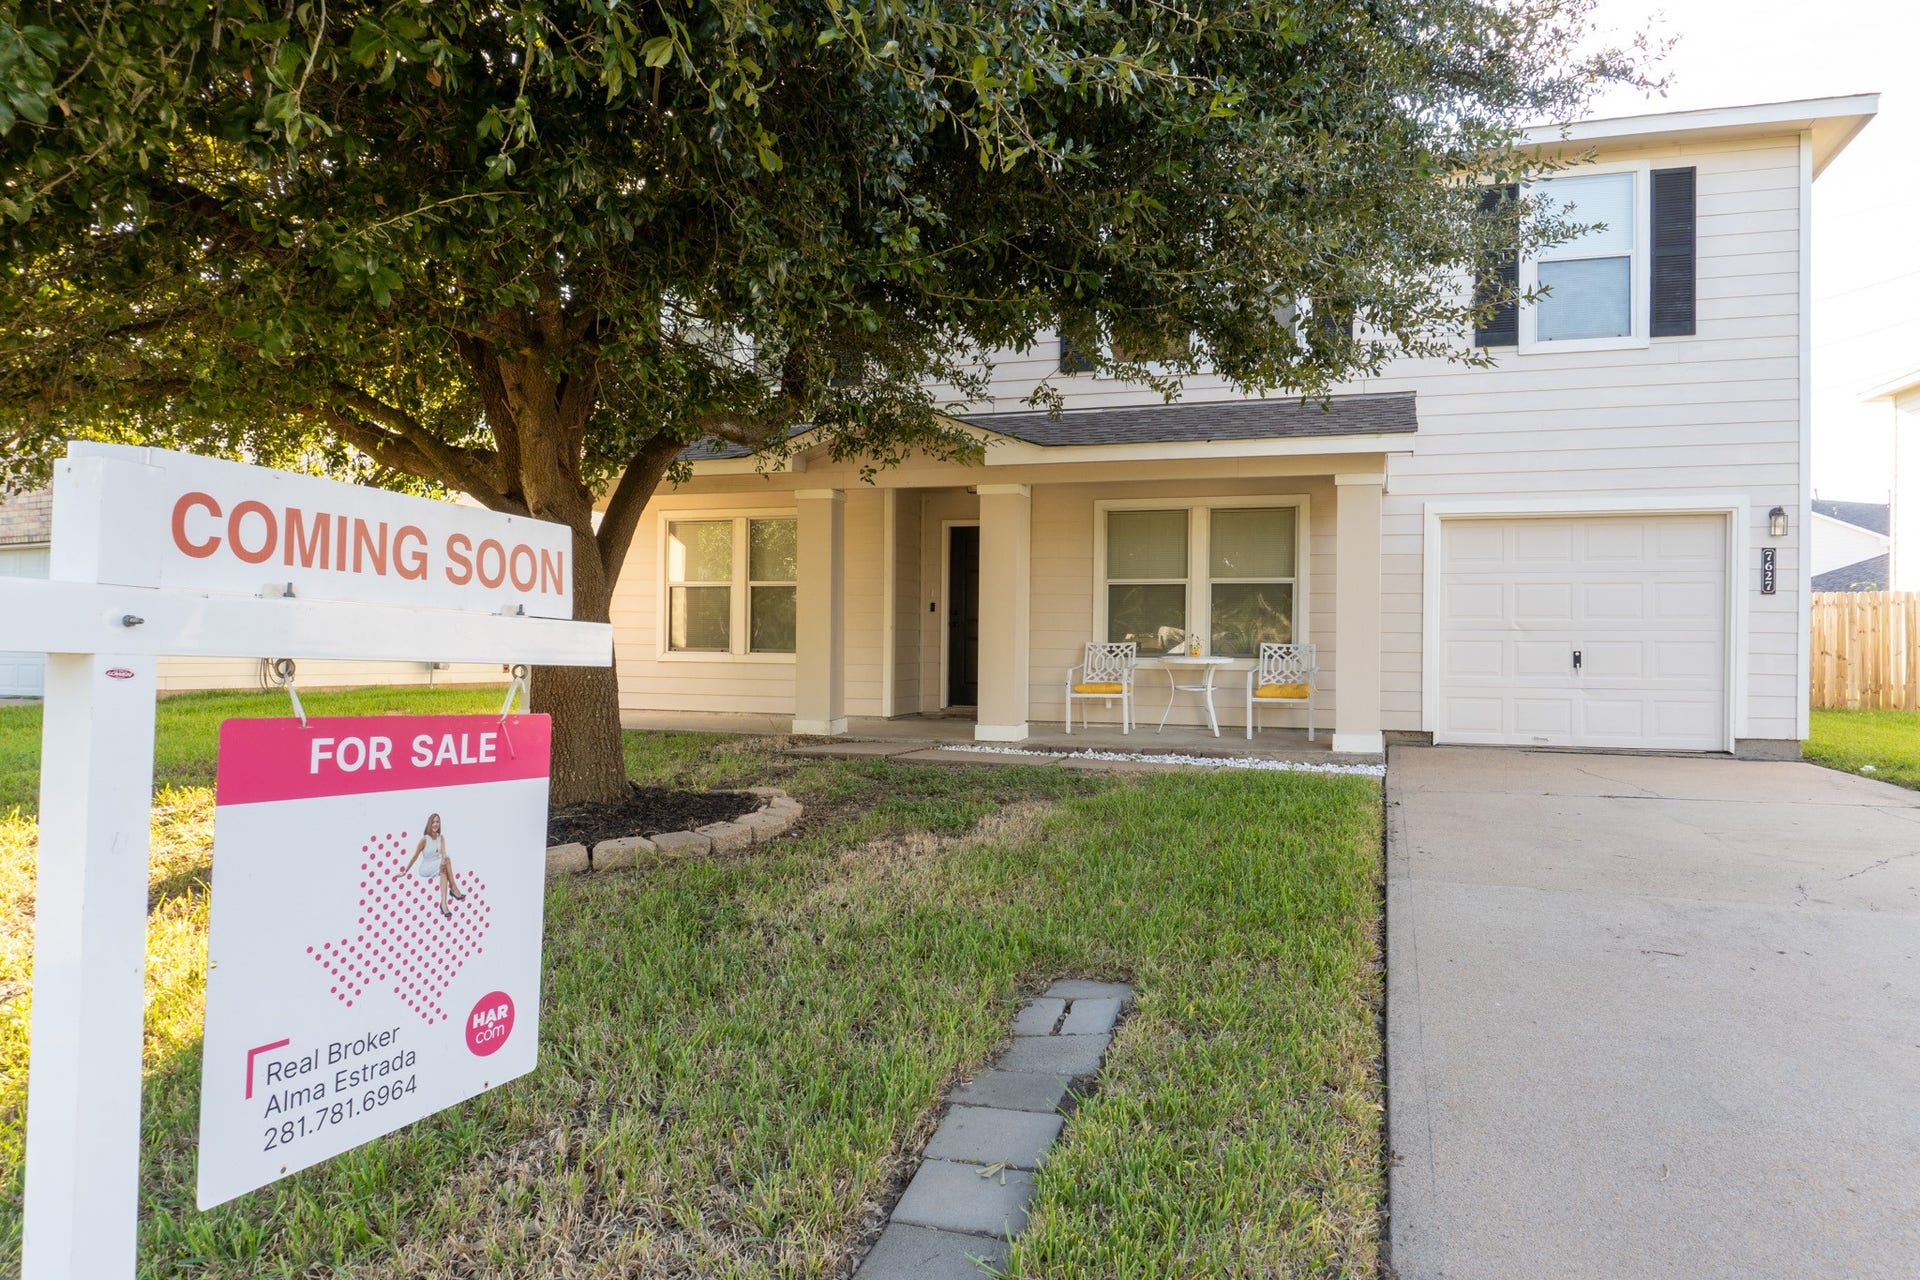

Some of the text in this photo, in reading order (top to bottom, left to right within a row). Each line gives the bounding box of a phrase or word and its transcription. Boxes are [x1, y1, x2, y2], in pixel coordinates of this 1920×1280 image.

[171, 491, 565, 596] COMING SOON
[1764, 551, 1773, 591] 7627
[309, 732, 498, 775] FOR SALE
[473, 1004, 509, 1029] HAR
[263, 1050, 416, 1119] Alma Estrada
[266, 1027, 401, 1086] Real Broker
[263, 1074, 418, 1152] 281.781.6964
